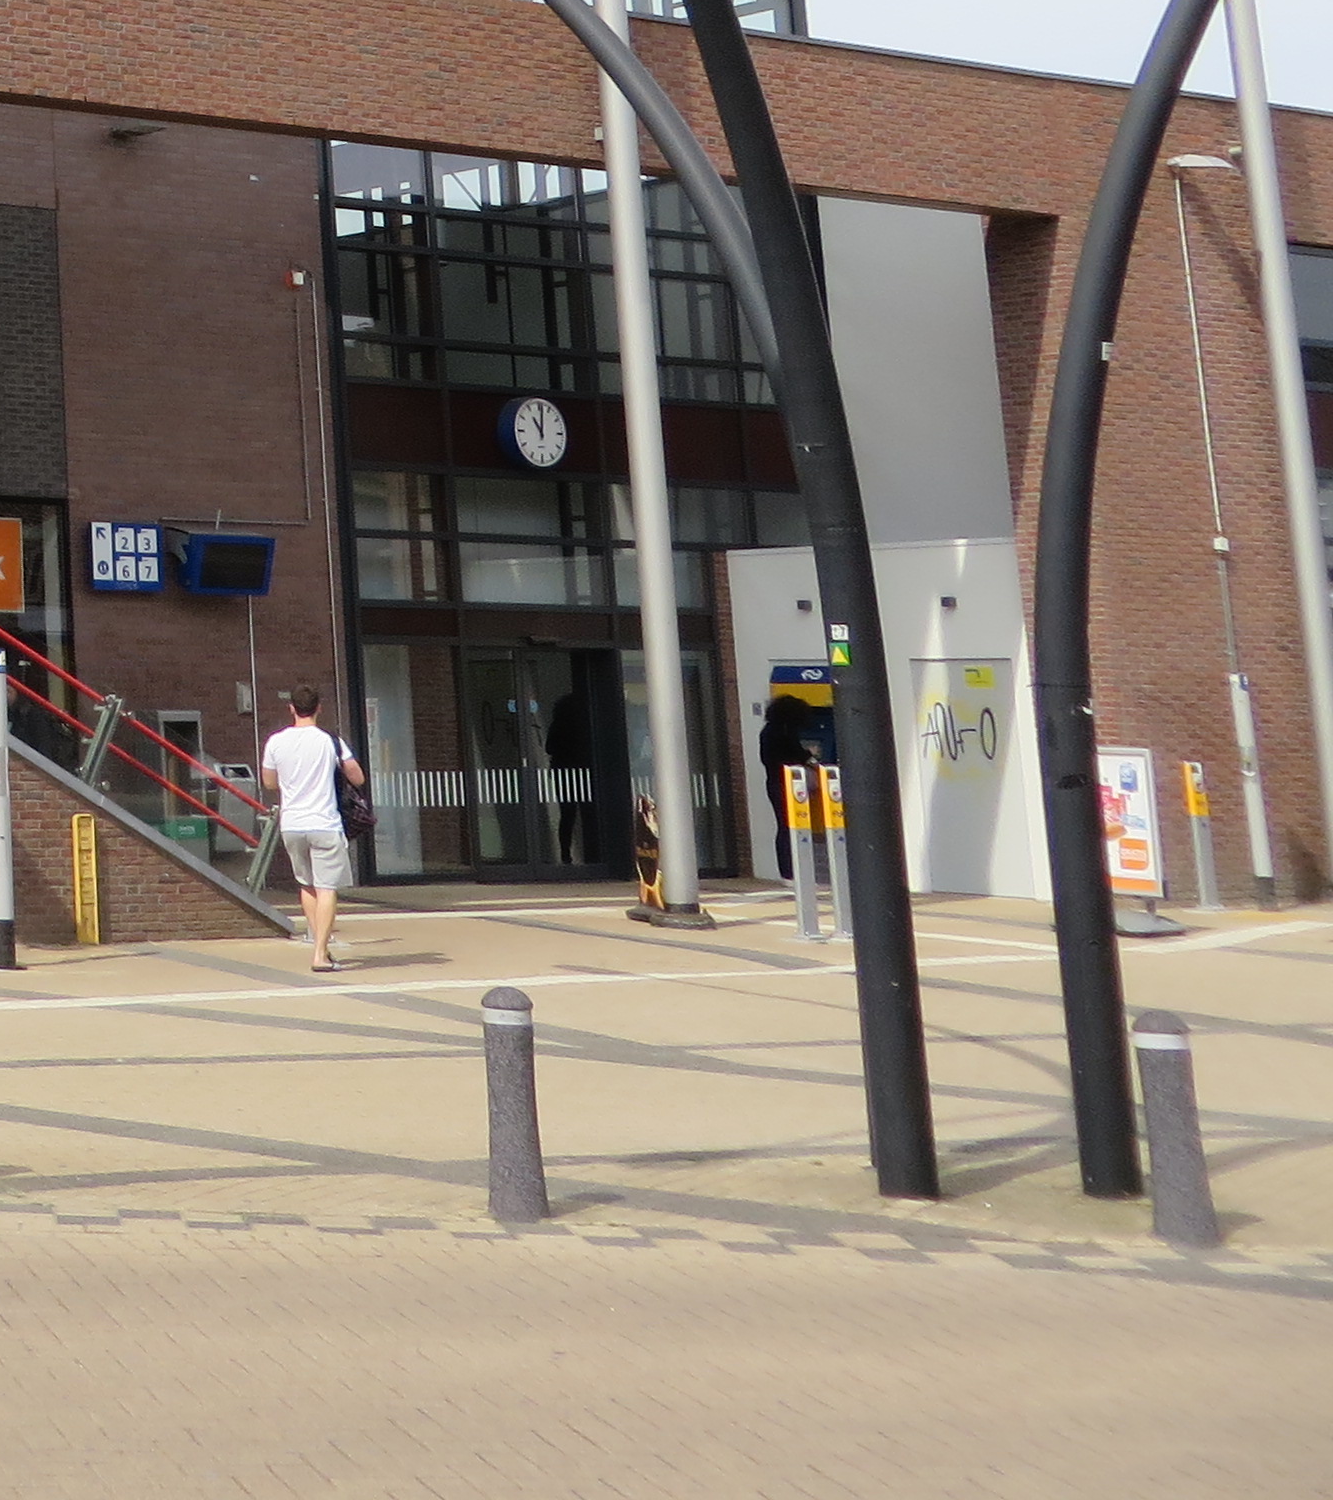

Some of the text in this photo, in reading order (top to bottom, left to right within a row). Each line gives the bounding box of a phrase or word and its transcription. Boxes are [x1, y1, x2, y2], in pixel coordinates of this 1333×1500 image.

[121, 536, 151, 551] 2 3
[122, 565, 152, 579] 6 7
